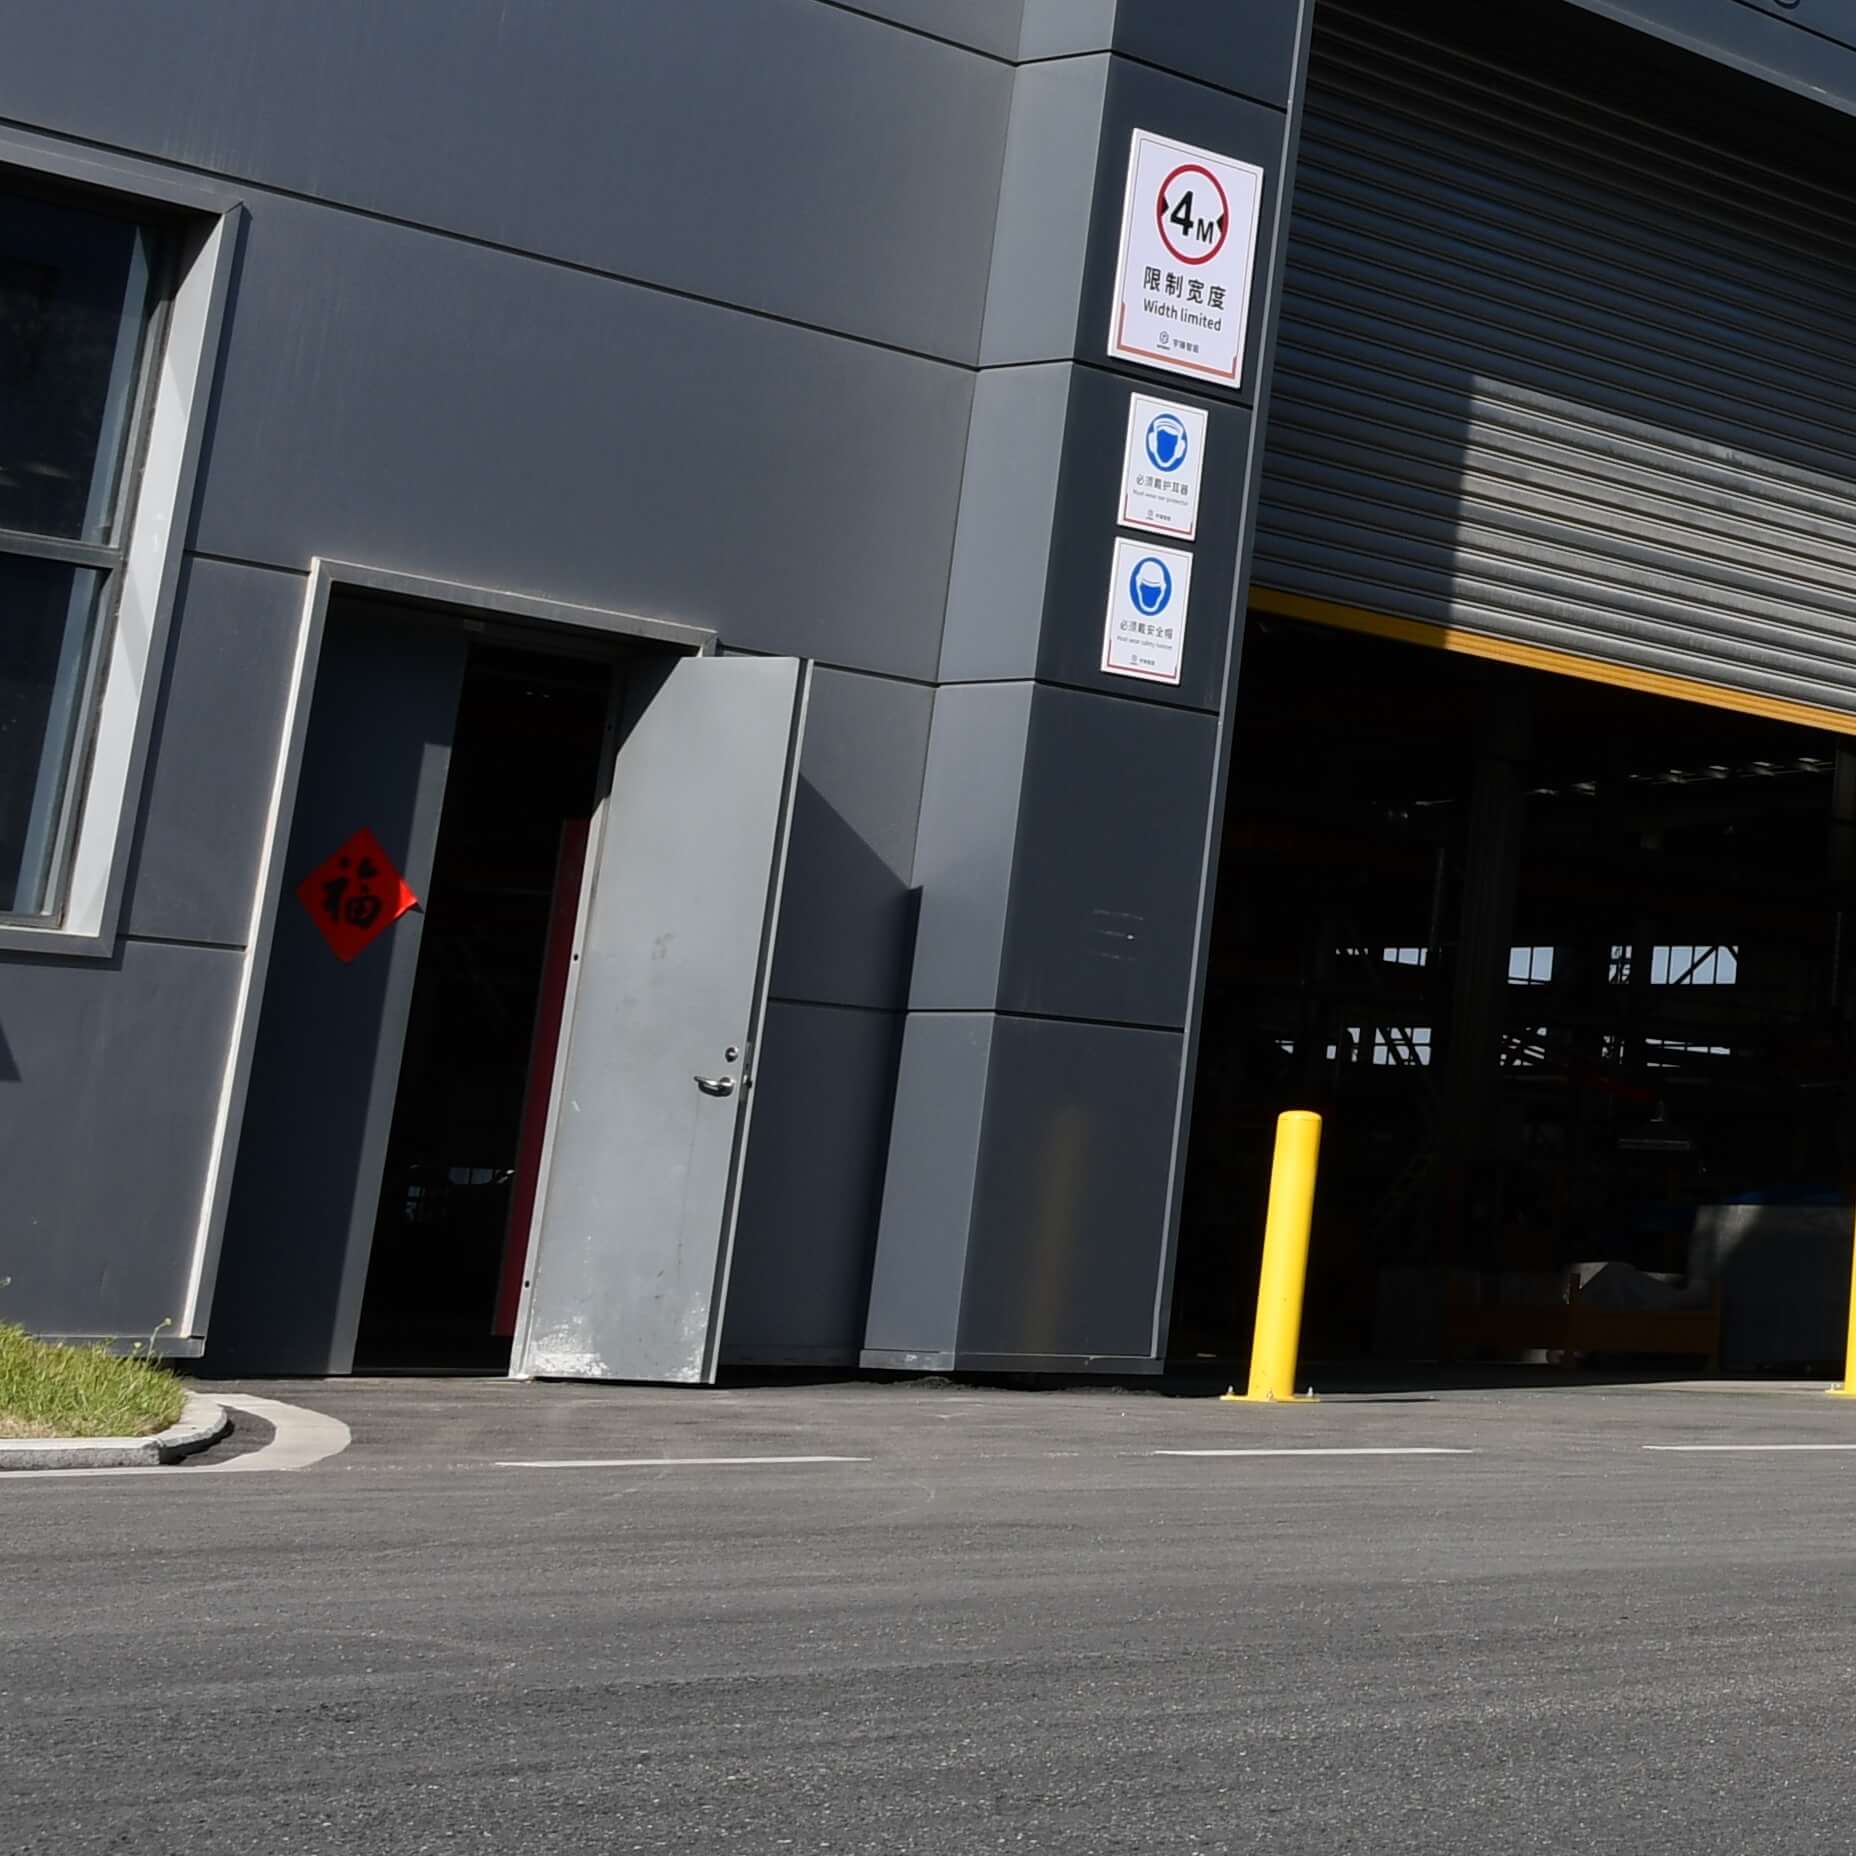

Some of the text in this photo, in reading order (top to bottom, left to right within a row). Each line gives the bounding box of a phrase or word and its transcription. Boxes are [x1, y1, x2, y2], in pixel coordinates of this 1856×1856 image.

[1143, 265, 1226, 310] 限制宽度
[1143, 297, 1222, 332] Width limited
[322, 857, 382, 930] 福
